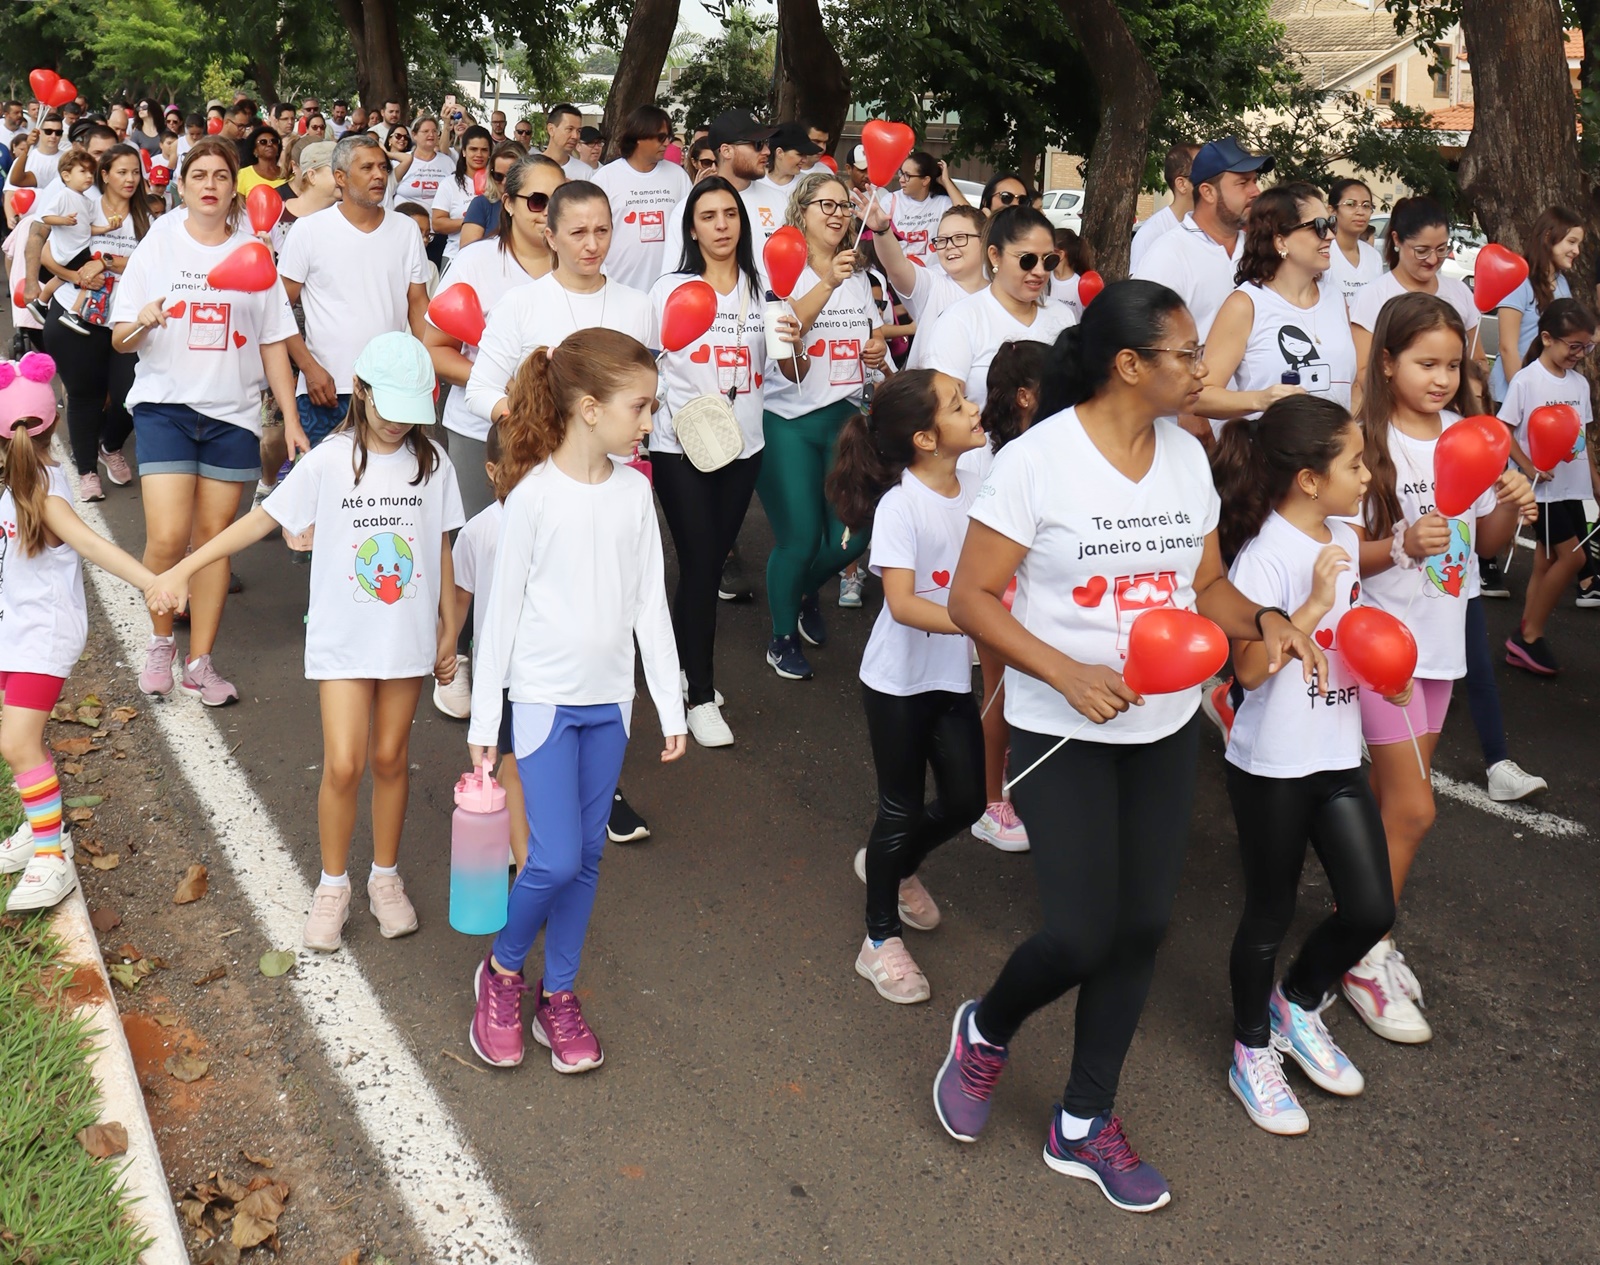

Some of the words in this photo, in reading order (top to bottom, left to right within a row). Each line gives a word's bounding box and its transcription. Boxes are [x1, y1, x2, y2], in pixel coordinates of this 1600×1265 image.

[181, 270, 192, 279] Te
[1058, 298, 1076, 307] undo
[715, 311, 739, 320] amar
[748, 311, 761, 320] de
[827, 307, 857, 316] amarei
[708, 324, 727, 333] eiro
[727, 326, 735, 334] a
[736, 324, 765, 336] janeir
[849, 319, 869, 329] janei
[1403, 479, 1428, 495] Até
[341, 495, 364, 509] Até
[367, 497, 376, 507] o
[379, 495, 423, 507] mundo
[352, 514, 414, 529] acabar...
[1091, 516, 1113, 531] Te
[1117, 511, 1173, 530] amarei
[1174, 510, 1192, 525] de
[1077, 540, 1142, 560] janeiro
[1146, 539, 1157, 552] a
